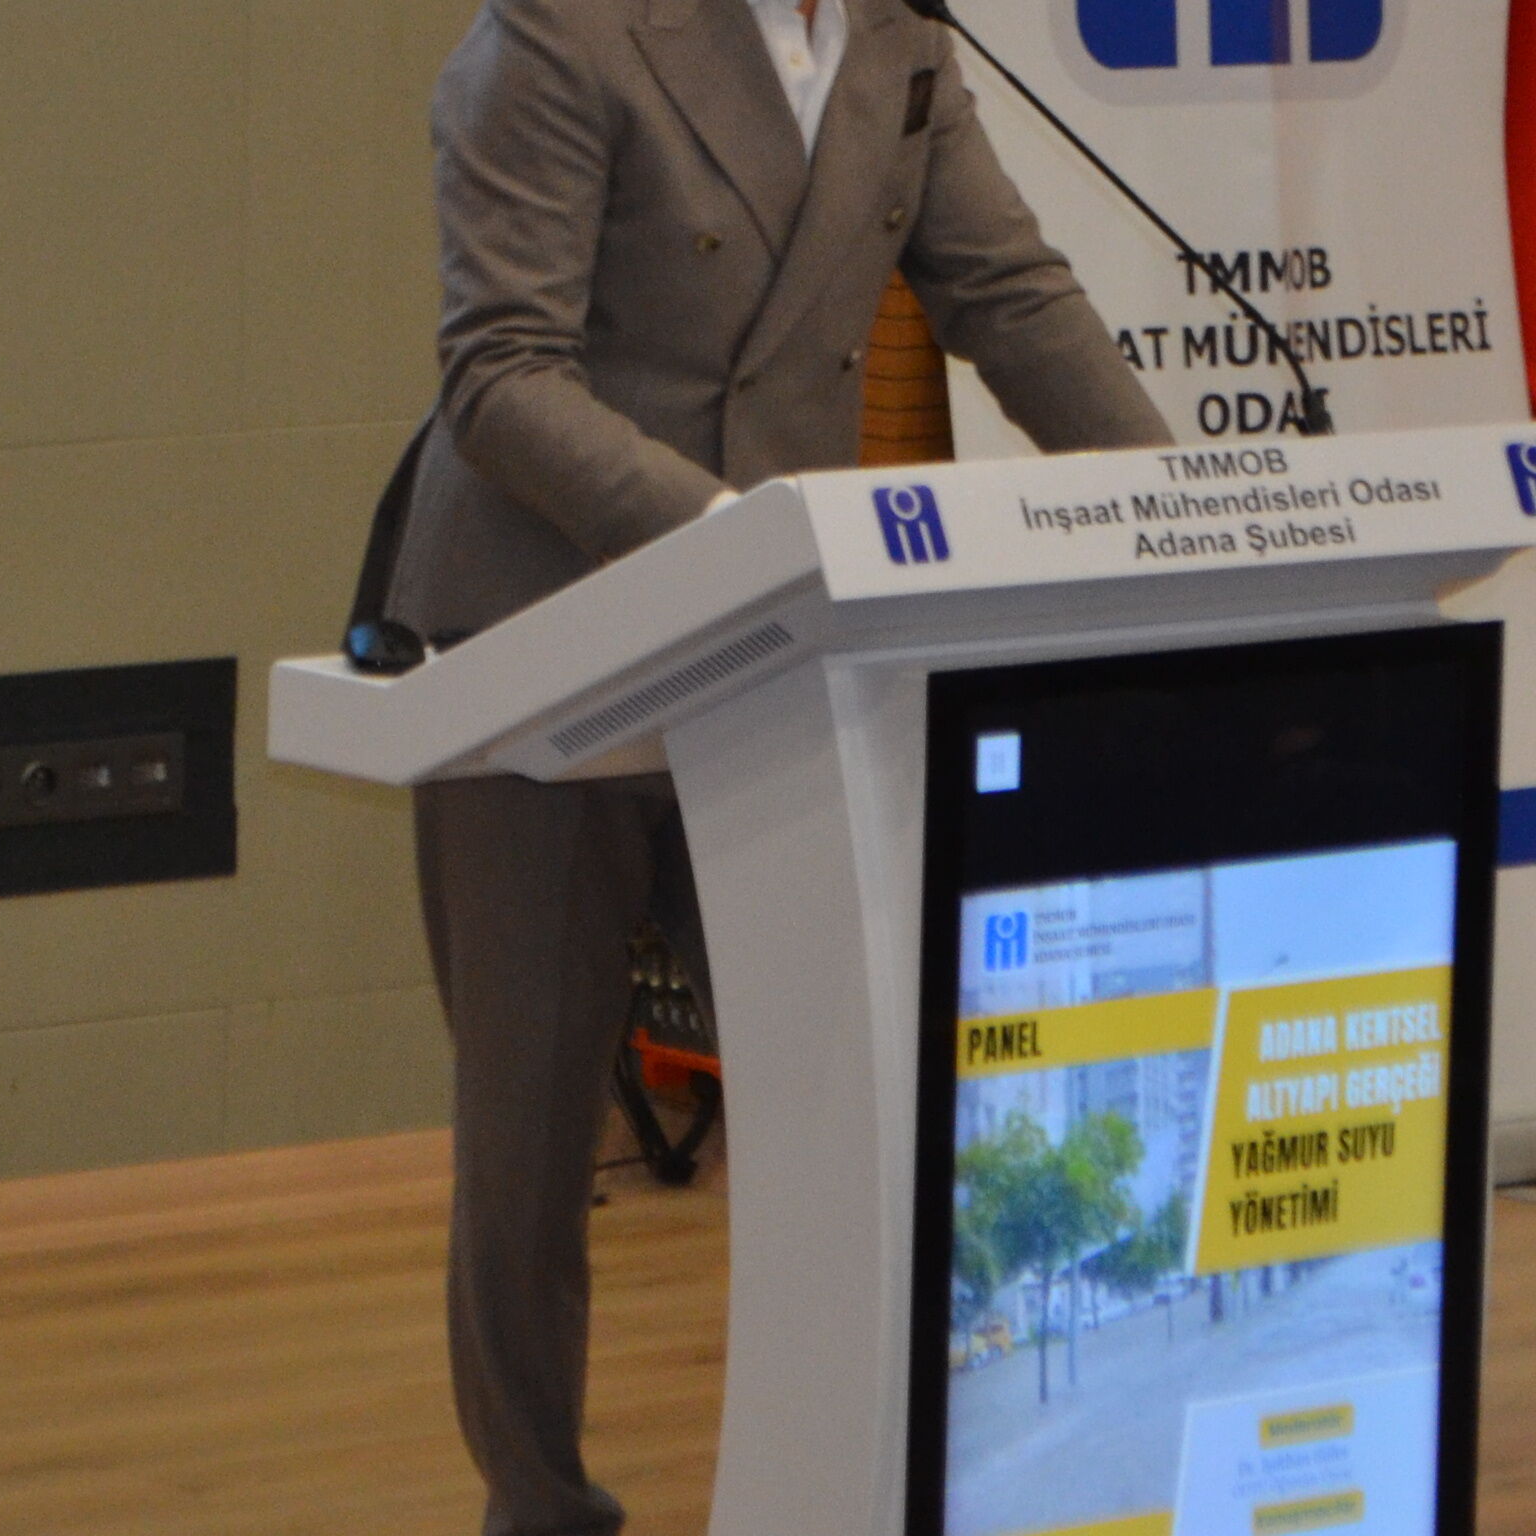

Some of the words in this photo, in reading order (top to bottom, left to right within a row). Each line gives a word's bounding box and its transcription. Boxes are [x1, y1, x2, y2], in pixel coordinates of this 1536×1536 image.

[1177, 247, 1332, 296] TMMOB
[1158, 448, 1289, 483] TMMOB
[1020, 497, 1124, 533] İnşaat
[1133, 480, 1341, 523] Mühendisleri
[1349, 477, 1442, 507] Odası
[1134, 528, 1236, 560] Adana
[1245, 517, 1357, 553] Şubesi
[966, 1020, 1042, 1066] PANEL
[1246, 1073, 1339, 1124] ALTYAPI
[1231, 1128, 1328, 1179] YAĞMUR
[1338, 1122, 1396, 1164] SUYU
[1230, 1178, 1339, 1238] YÖNETİMİ
